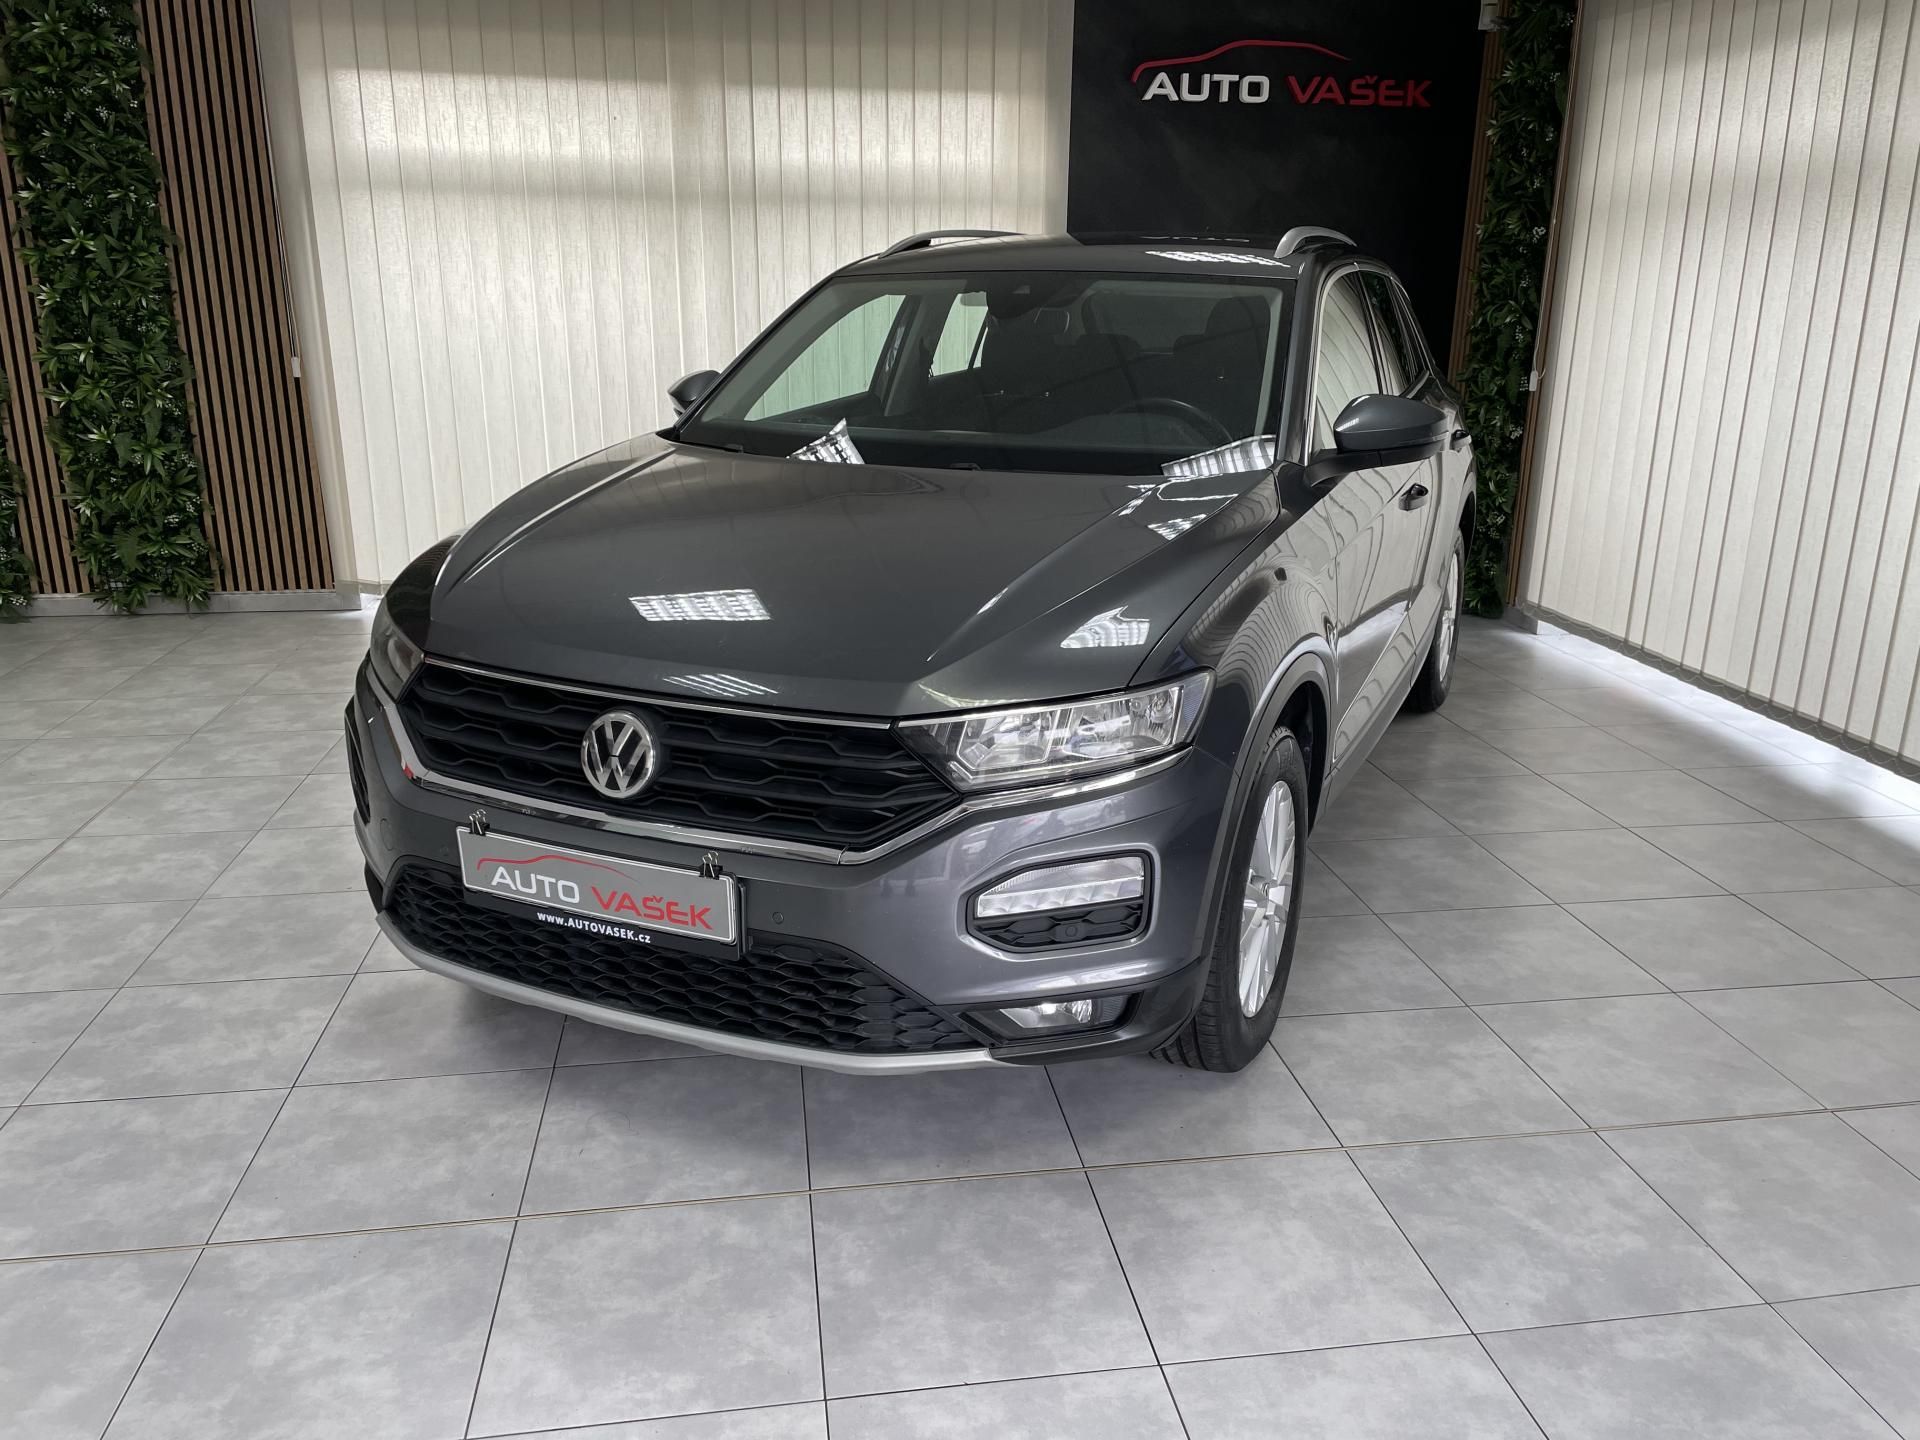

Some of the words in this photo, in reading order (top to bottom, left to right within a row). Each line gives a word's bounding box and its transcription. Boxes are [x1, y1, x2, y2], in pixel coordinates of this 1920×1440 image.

[1141, 72, 1270, 103] AUTO
[1288, 75, 1432, 108] VAŠEK
[583, 711, 654, 797] VW
[491, 866, 579, 904] AUTO
[592, 886, 713, 930] VAŠEK
